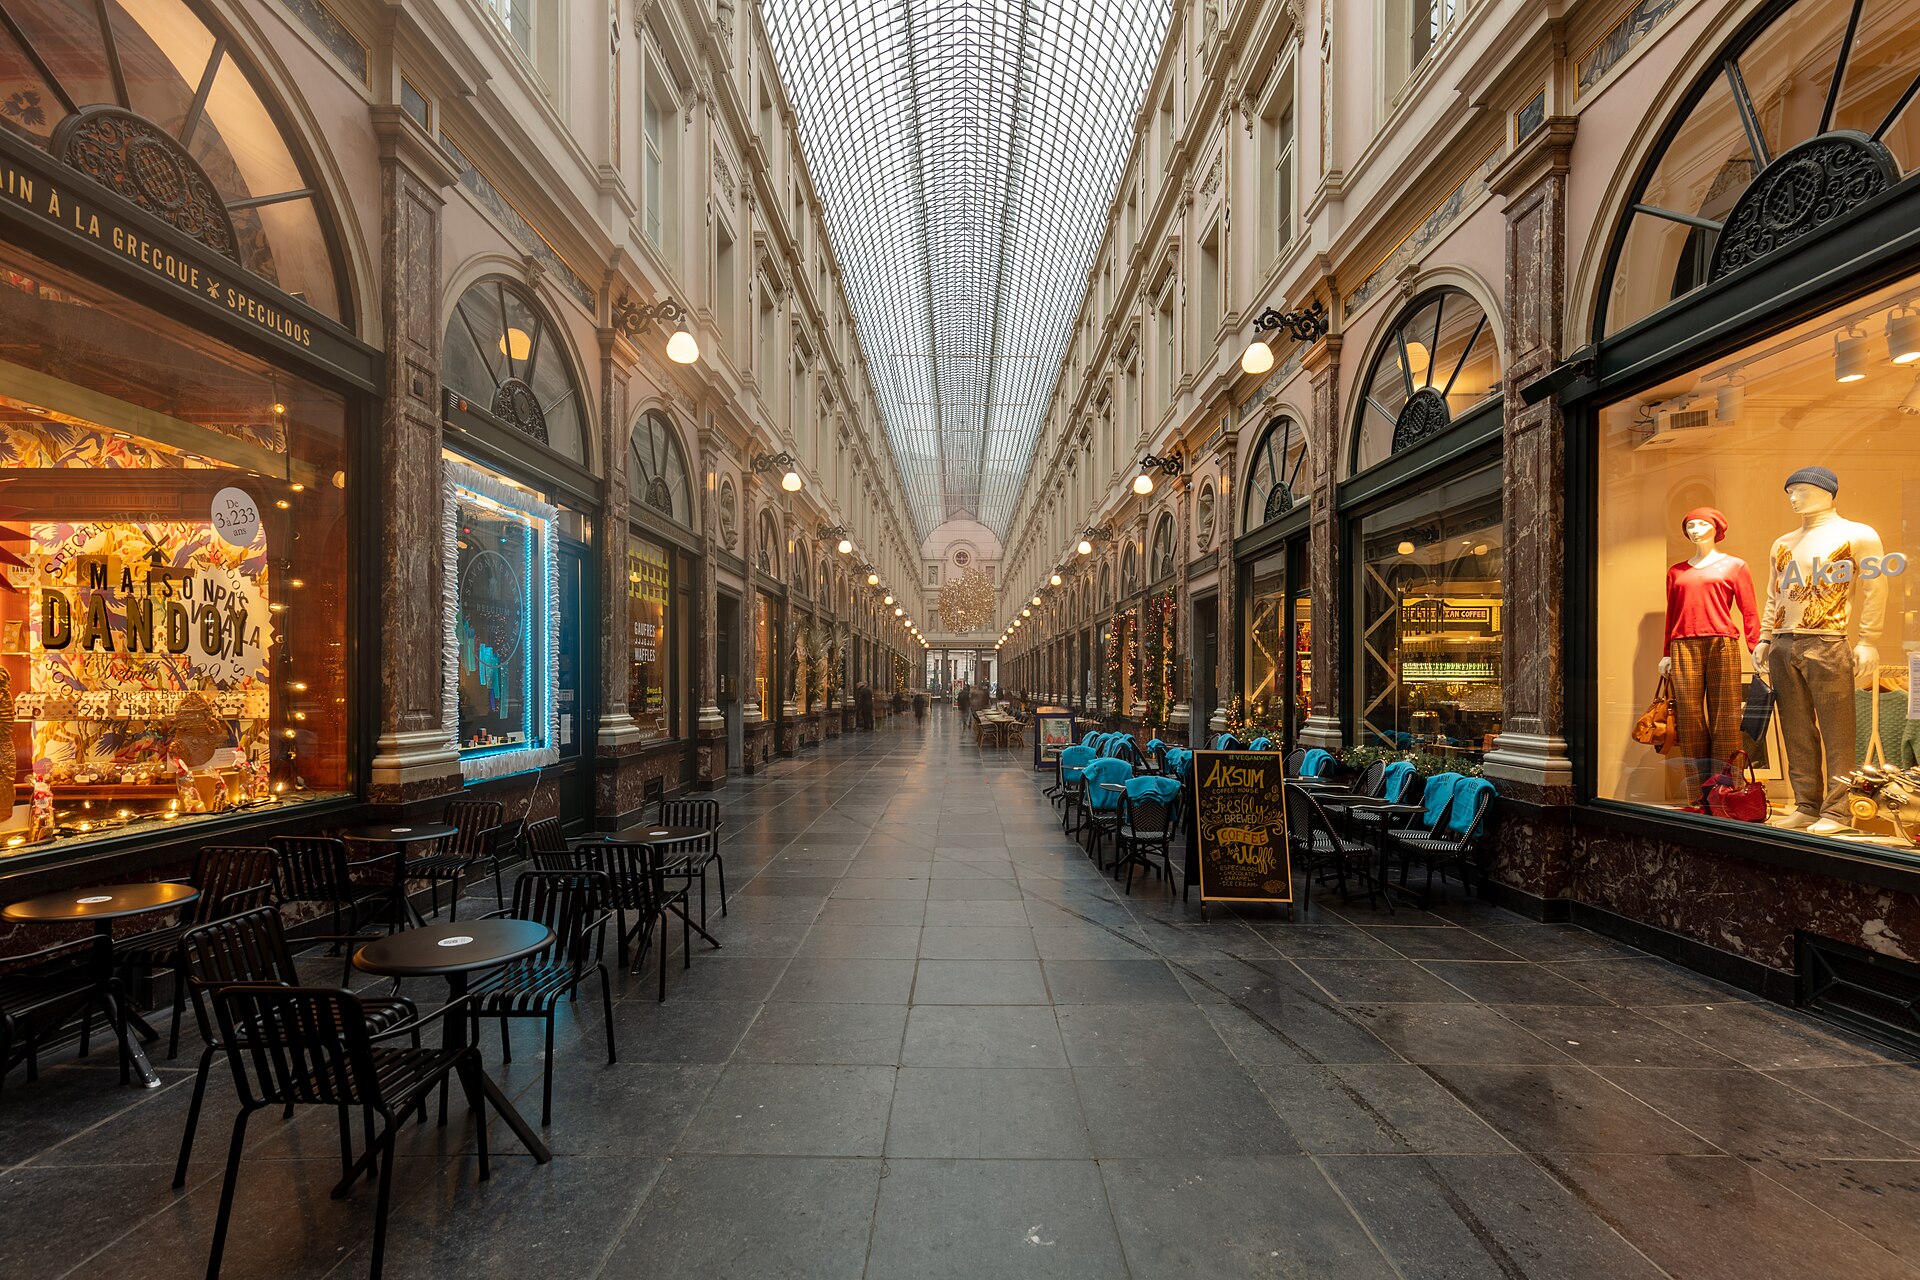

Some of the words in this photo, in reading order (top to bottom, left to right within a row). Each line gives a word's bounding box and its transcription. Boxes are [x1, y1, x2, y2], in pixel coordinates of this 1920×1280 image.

[0, 166, 33, 204] IN
[48, 188, 60, 218] À
[75, 205, 100, 239] LA
[113, 226, 199, 290] GRECQUE
[227, 288, 311, 347] SPECULOOS
[226, 499, 239, 509] De
[215, 512, 226, 529] 3
[230, 507, 256, 526] 233
[233, 528, 247, 537] ans
[1781, 552, 1908, 590] Akaso
[90, 562, 215, 602] MAISON
[1461, 610, 1486, 618] COFFEE
[41, 588, 248, 657] DANDOY
[634, 621, 656, 637] GAUFRES
[634, 647, 656, 661] WAFFLES
[109, 688, 135, 701] Rue
[139, 690, 156, 700] au
[1203, 759, 1265, 789] AKSUM
[1224, 814, 1257, 824] BREWED
[1221, 829, 1267, 844] COFFEE
